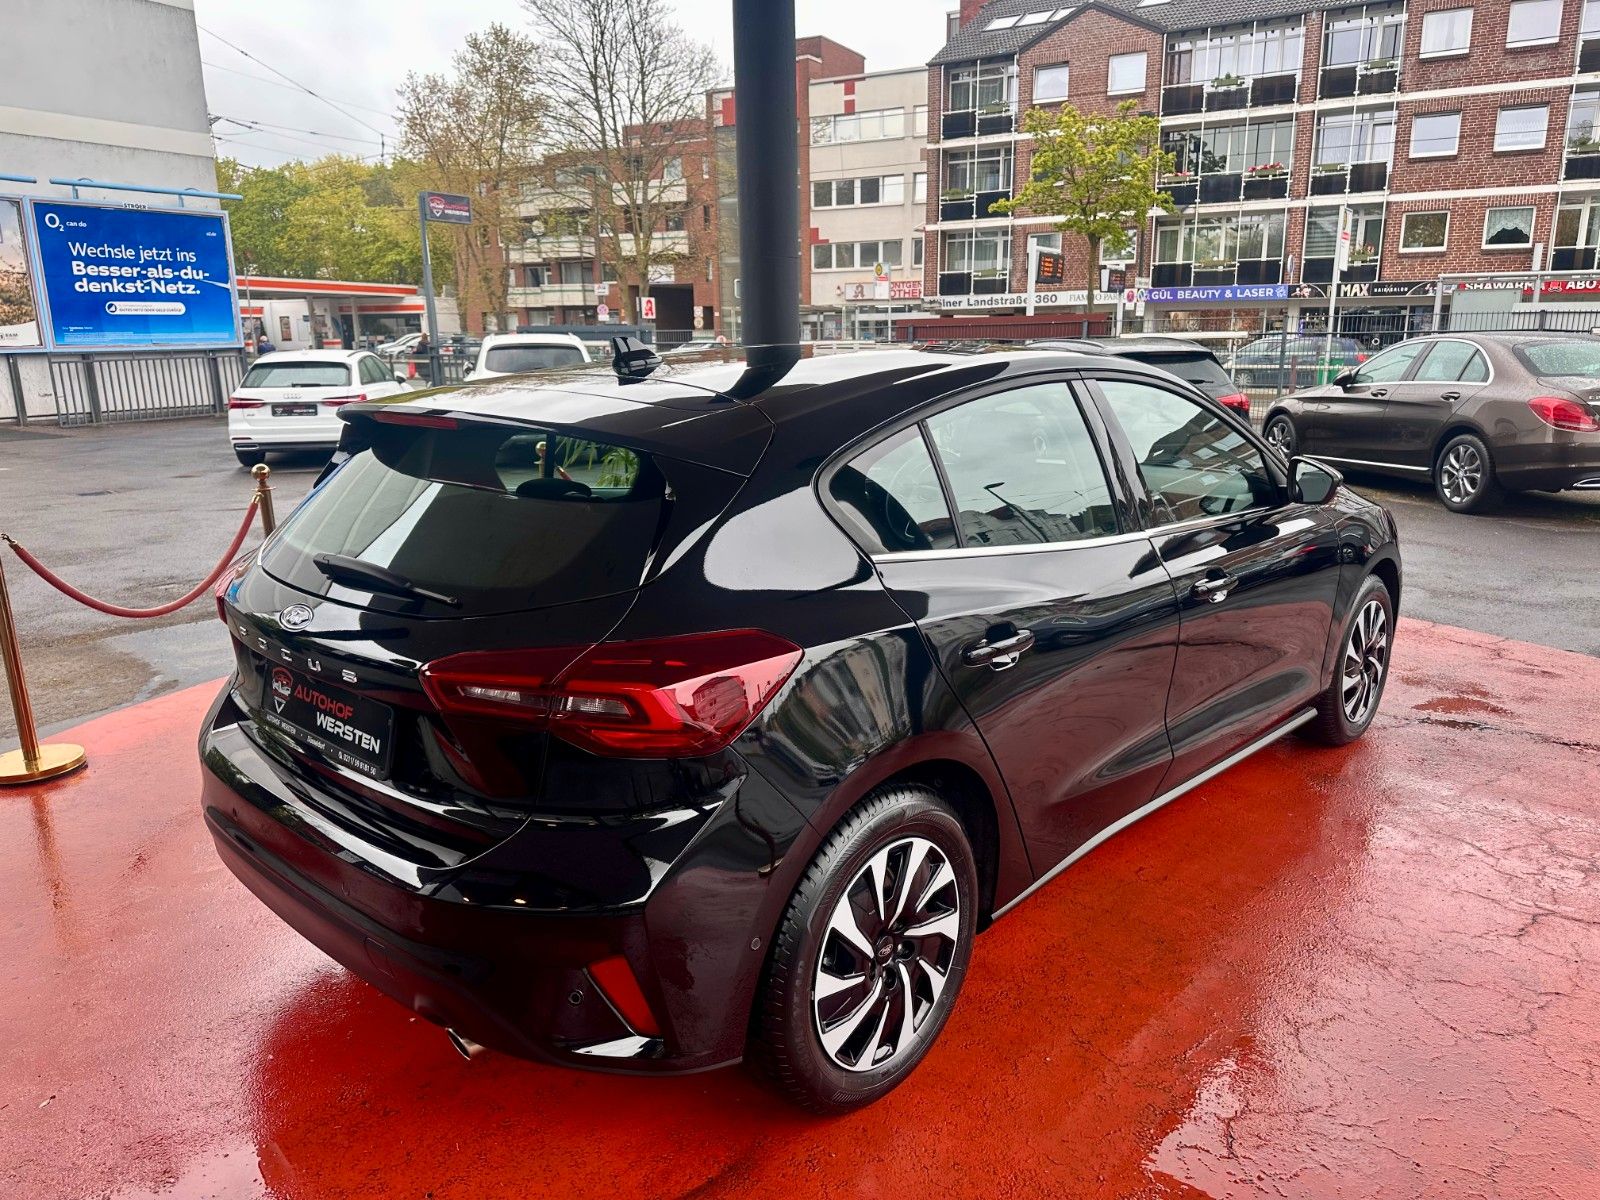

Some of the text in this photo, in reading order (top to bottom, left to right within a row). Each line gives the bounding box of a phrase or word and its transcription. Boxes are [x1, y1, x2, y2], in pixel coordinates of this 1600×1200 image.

[68, 242, 197, 264] Wechsle jetzt ins
[72, 261, 209, 279] Besser-als-du-
[74, 278, 201, 295] denkst-Netz.
[1152, 287, 1273, 300] GÜL BEAUTY & LASER
[1340, 283, 1369, 297] MAX
[967, 296, 1028, 307] Landstraße
[1035, 295, 1057, 304] 360
[294, 684, 354, 720] AUTOHOF
[316, 711, 381, 754] WERSTEN
